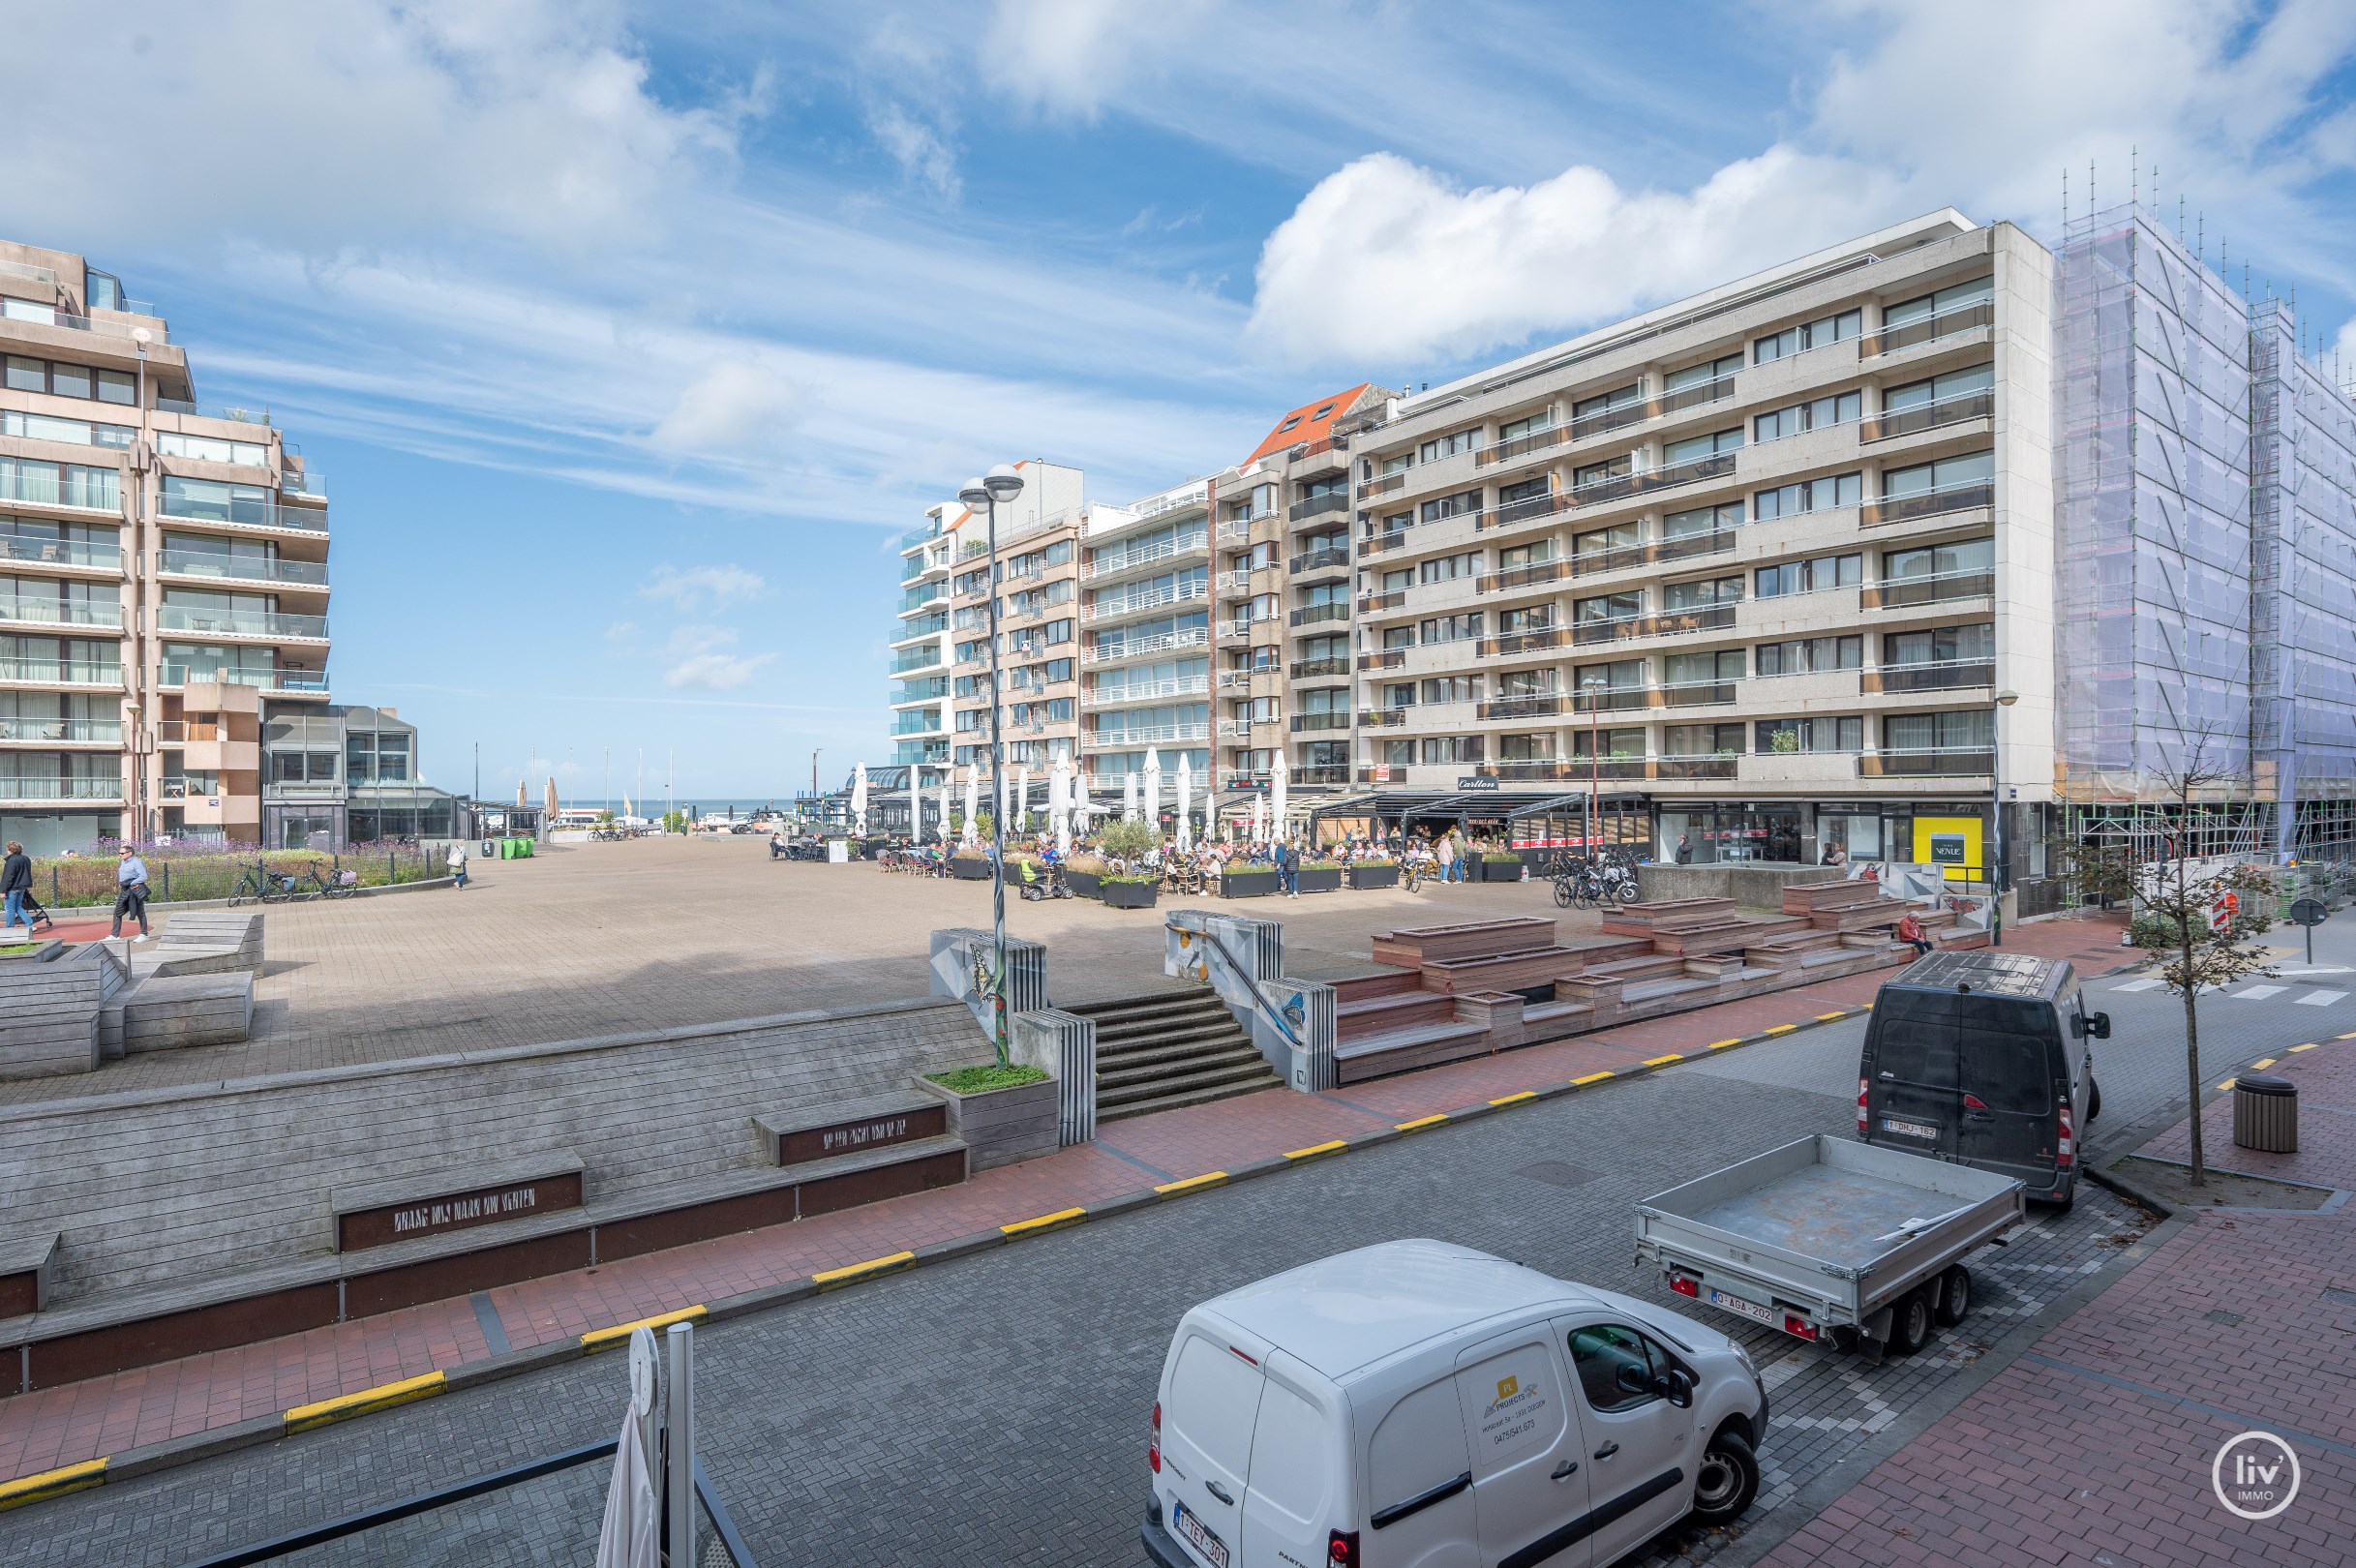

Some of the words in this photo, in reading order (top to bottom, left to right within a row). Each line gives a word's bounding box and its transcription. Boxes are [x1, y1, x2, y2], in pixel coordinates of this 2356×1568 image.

[1936, 847, 1961, 856] VENUE
[394, 1207, 428, 1232] DRAAG
[432, 1203, 451, 1225] MIJ
[454, 1197, 481, 1221] NAAR
[484, 1193, 498, 1216] UW
[501, 1188, 535, 1212] VERTEN
[1503, 1383, 1513, 1393] PL
[1496, 1393, 1525, 1411] PROJECTS
